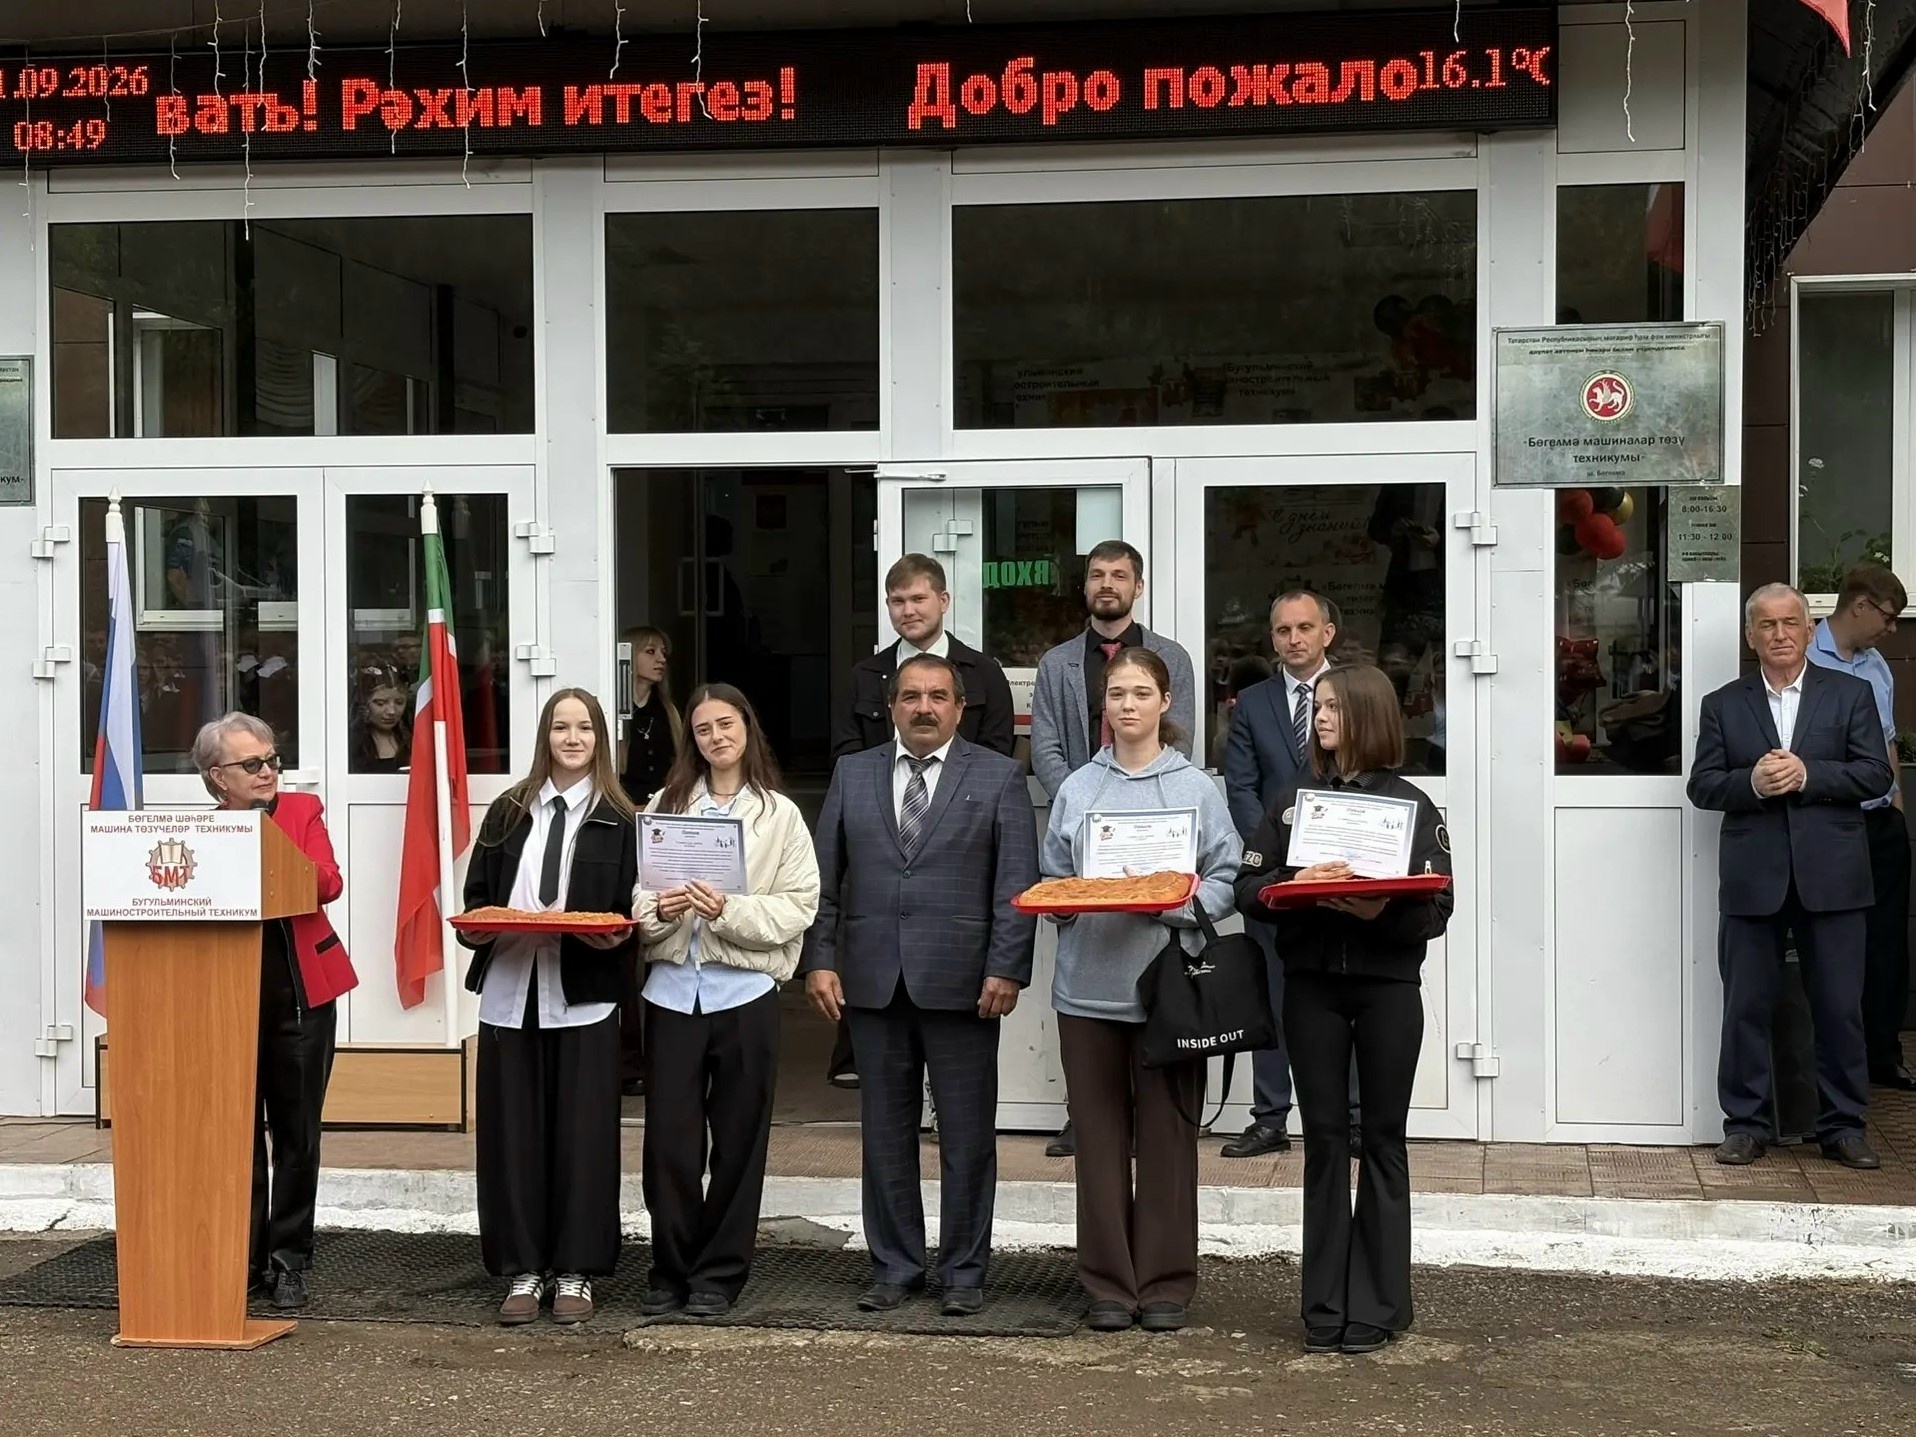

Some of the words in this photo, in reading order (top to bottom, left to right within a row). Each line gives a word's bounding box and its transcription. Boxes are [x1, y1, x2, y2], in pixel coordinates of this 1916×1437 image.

[156, 79, 317, 134] вать!
[341, 77, 541, 131] Рәхим
[563, 66, 795, 124] итегез!
[908, 57, 1119, 130] Добро
[1144, 57, 1417, 109] пожало
[14, 119, 106, 149] 08:49
[1583, 437, 1655, 446] машиналар
[1659, 435, 1685, 446] төзү
[90, 825, 132, 833] МАШИНА
[195, 825, 253, 833] ТЕХНИКУМЫ
[132, 897, 212, 906] БУГУЛЬМИНСКИЙ
[86, 907, 206, 917] МАШИНОСТРОИТЕЛЬНЫЙ
[209, 908, 258, 917] ТЕХНИКУМ
[1176, 1036, 1217, 1049] INSIDE
[1219, 1029, 1244, 1043] OUT
